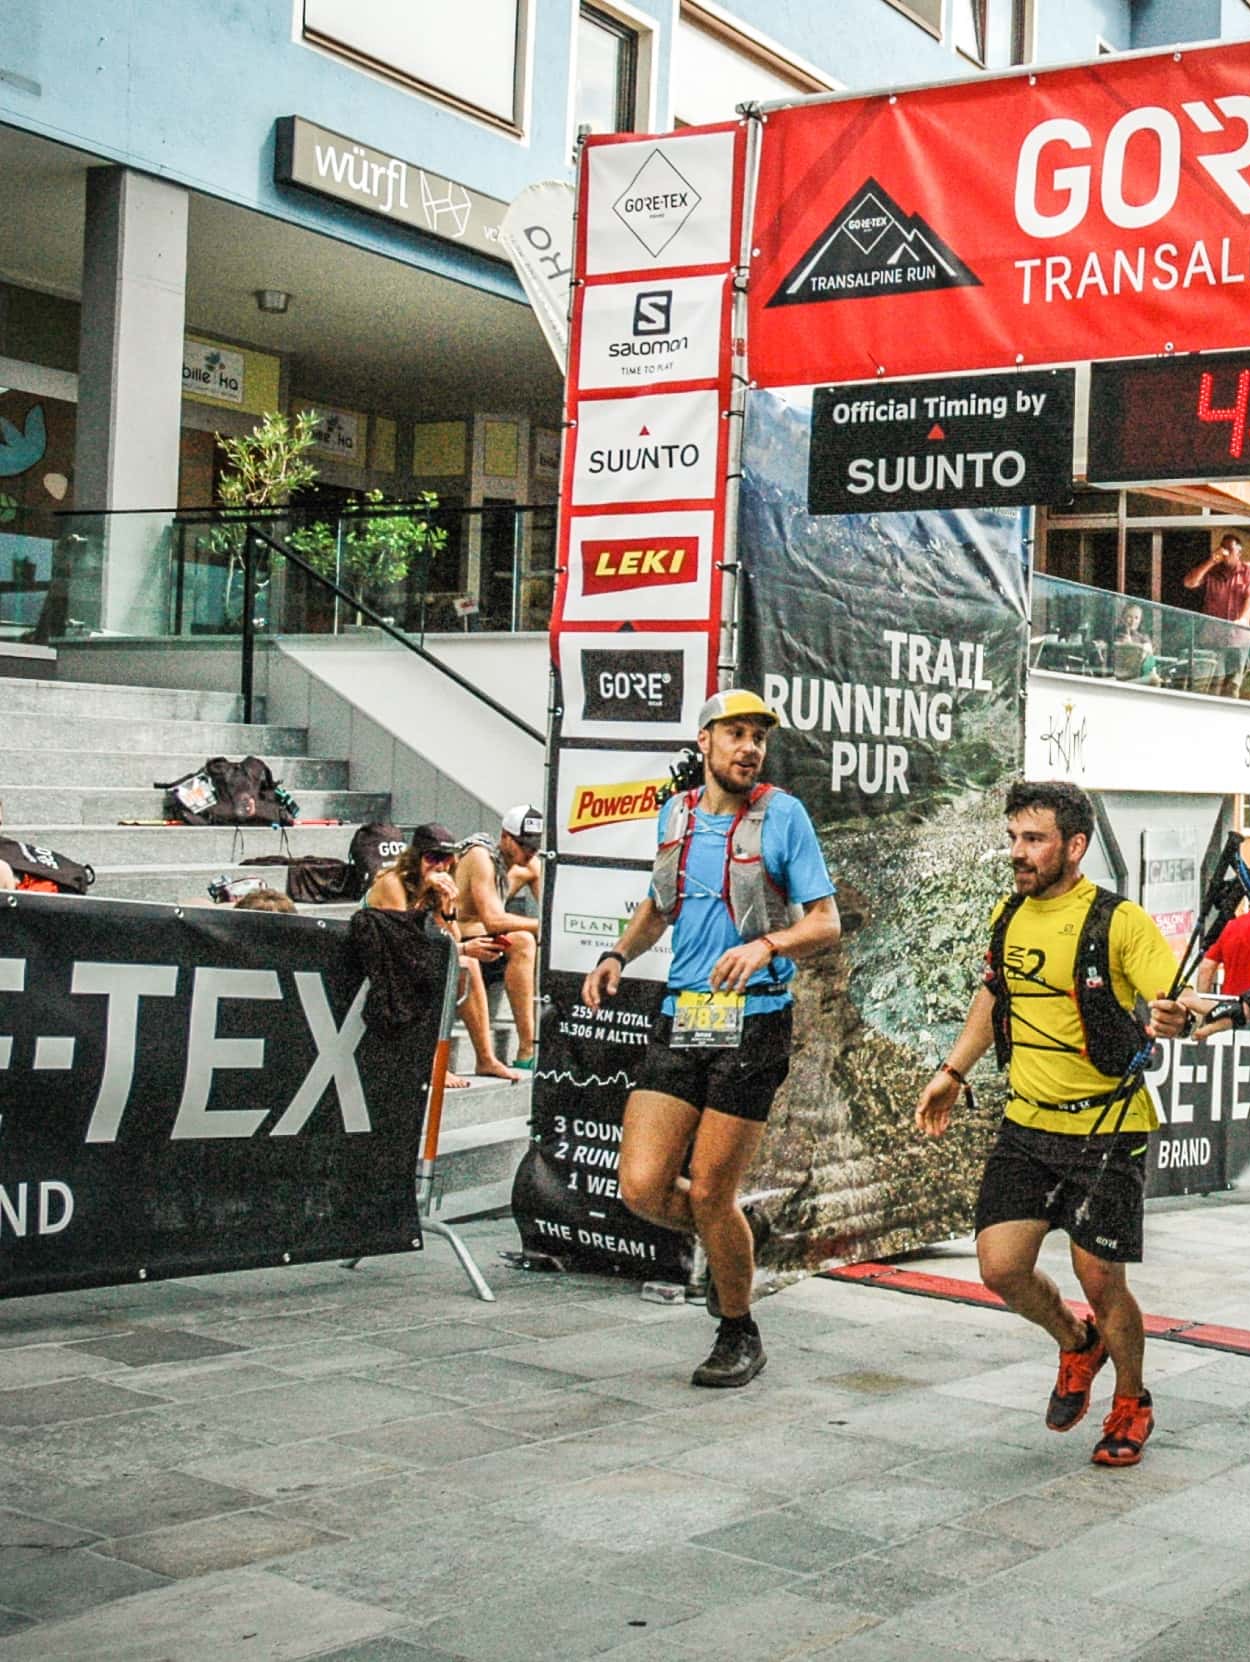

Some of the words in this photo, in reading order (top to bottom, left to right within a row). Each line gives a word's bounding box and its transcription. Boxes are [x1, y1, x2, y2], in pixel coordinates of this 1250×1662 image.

[315, 145, 409, 213] würfl
[625, 192, 688, 213] GORE-TEX
[811, 268, 903, 292] TRANSALPINE
[907, 264, 937, 281] RUN
[832, 399, 917, 424] Official
[924, 393, 1008, 421] Timing
[1016, 390, 1047, 416] by
[588, 443, 700, 474] SUUNTO
[845, 450, 1027, 495] SUUNTO
[594, 549, 686, 577] LEKI
[883, 629, 993, 692] TRAIL
[763, 673, 953, 741] RUNNING
[831, 740, 910, 795] PUR
[569, 919, 613, 932] PLAN
[572, 1005, 593, 1019] 255
[595, 1009, 614, 1023] KM
[616, 1011, 652, 1028] TOTAL
[594, 1027, 605, 1041] M
[553, 1115, 567, 1133] 3
[554, 1142, 569, 1160] 2
[1157, 1137, 1211, 1169] BRAND
[567, 1171, 579, 1191] 1
[534, 1218, 573, 1241] THE
